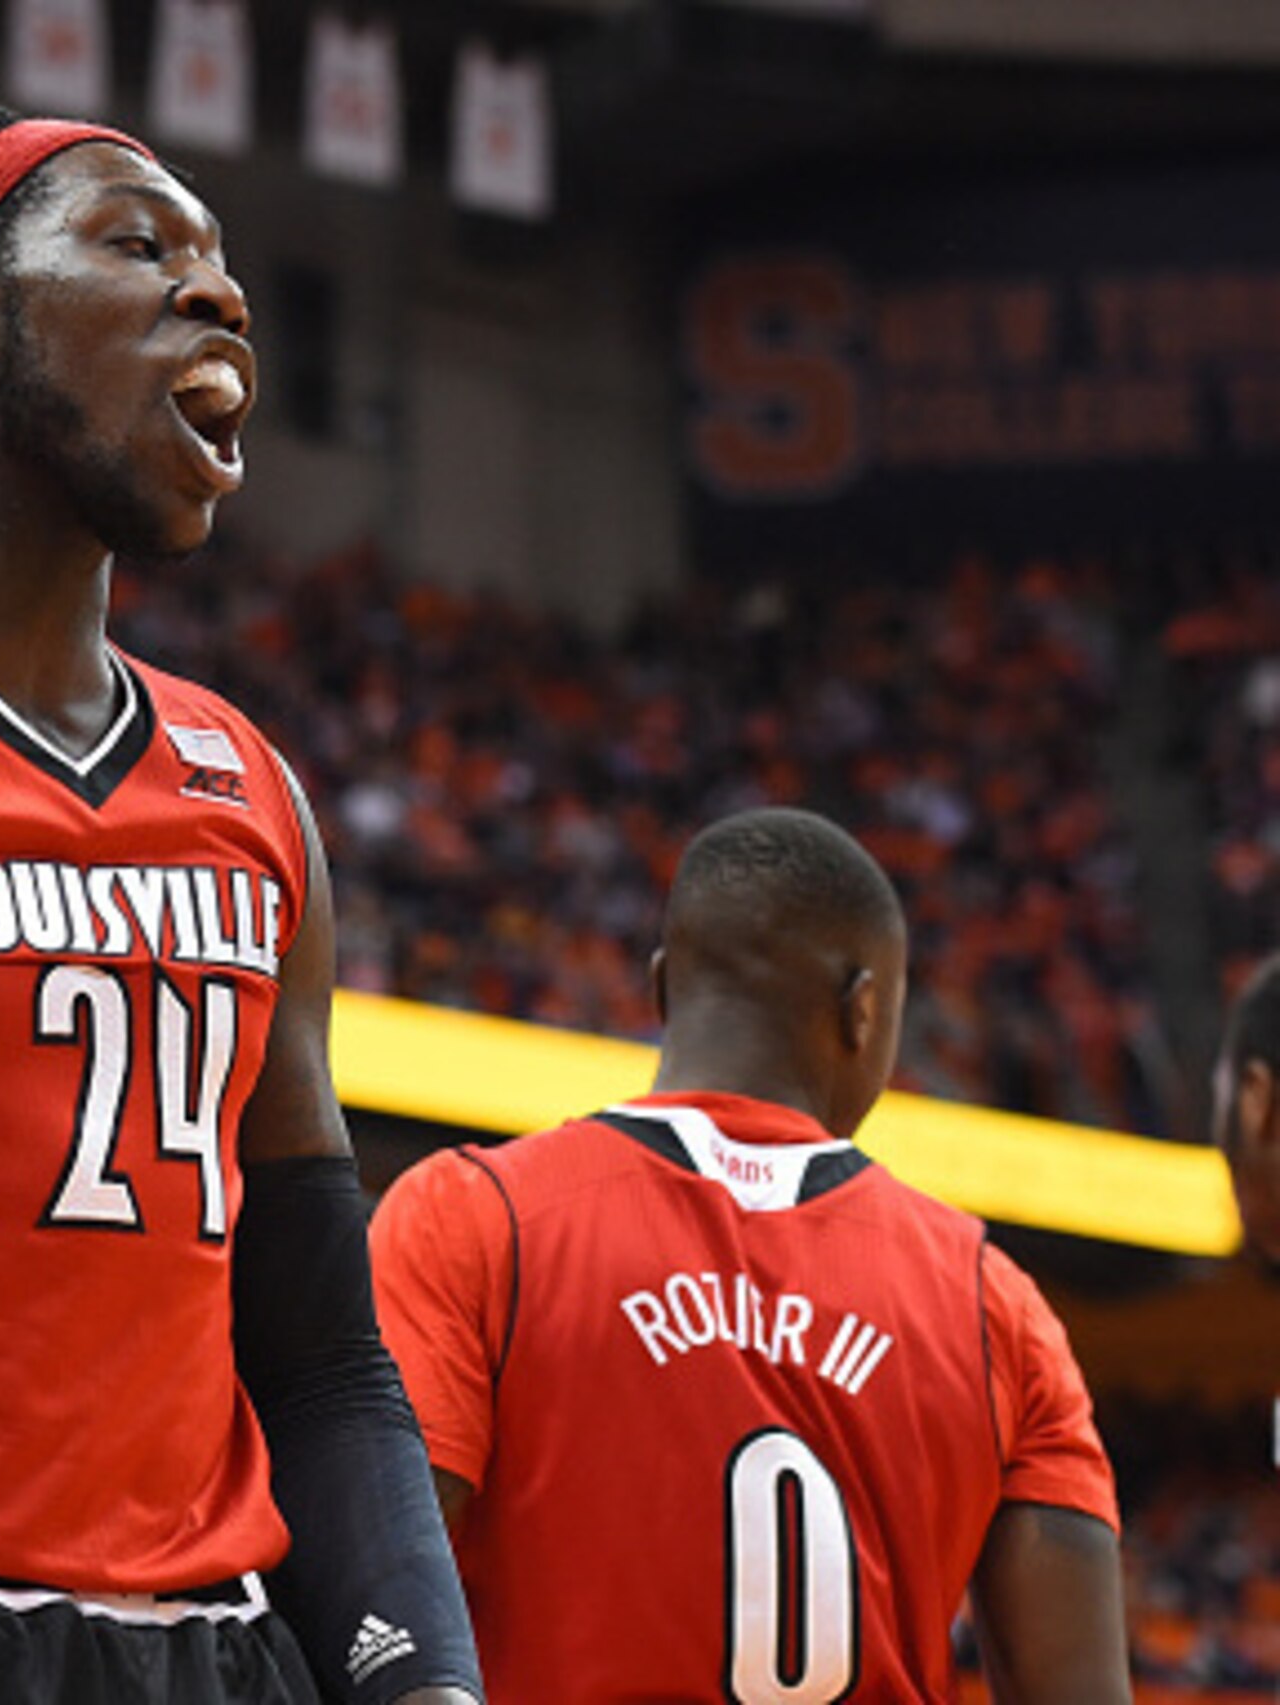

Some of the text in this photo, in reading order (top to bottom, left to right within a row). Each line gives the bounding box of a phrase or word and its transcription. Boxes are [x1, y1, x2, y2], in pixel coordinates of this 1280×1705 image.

[688, 252, 860, 496] S
[32, 960, 236, 1244] 24
[817, 1312, 893, 1396] III
[723, 1425, 861, 1705] 0
